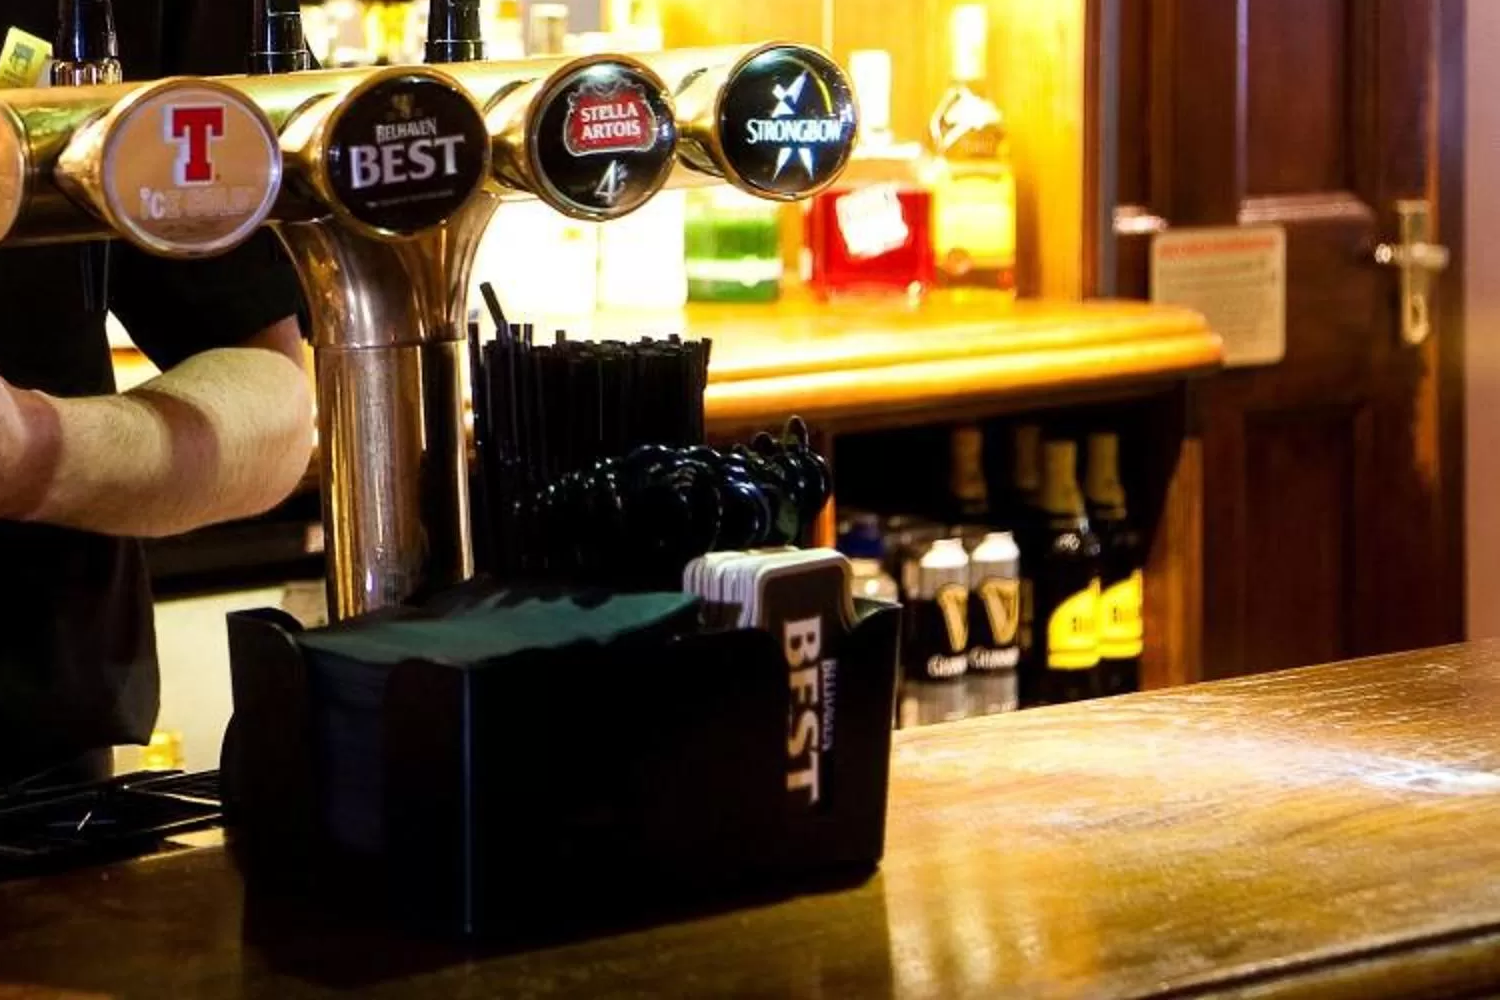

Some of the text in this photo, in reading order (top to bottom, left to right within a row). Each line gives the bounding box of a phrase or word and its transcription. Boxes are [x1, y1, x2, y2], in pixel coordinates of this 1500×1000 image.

[580, 101, 639, 123] STELLA
[375, 117, 437, 144] BELHAVEN
[581, 119, 641, 140] ARTOIS
[746, 117, 842, 145] STRONGBOW
[349, 134, 466, 190] BEST
